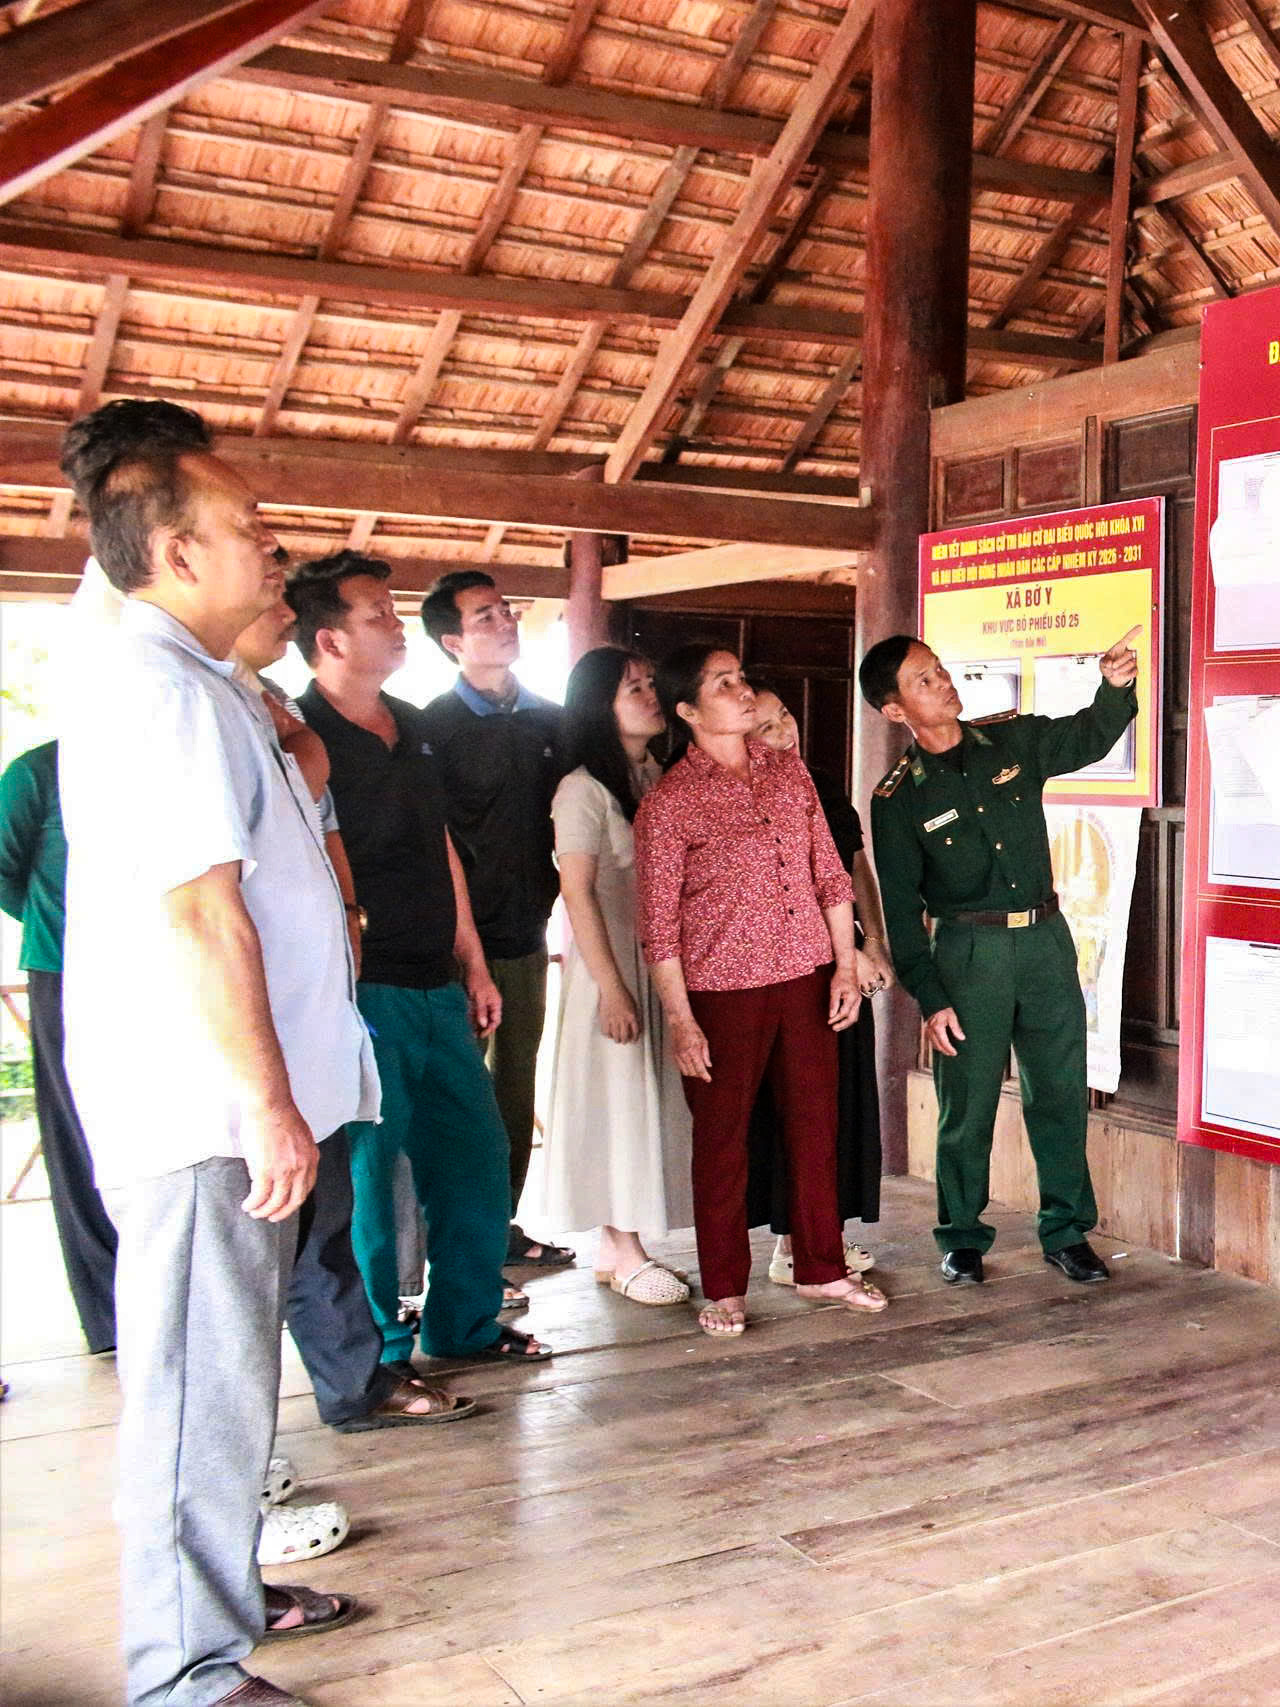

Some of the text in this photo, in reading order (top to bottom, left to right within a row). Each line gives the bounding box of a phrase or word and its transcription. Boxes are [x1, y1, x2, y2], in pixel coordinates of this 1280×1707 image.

[1110, 514, 1130, 536] KHÓA
[1132, 515, 1144, 532] XVI
[1087, 547, 1097, 567] KỲ
[1099, 548, 1116, 565] 2026
[1124, 545, 1141, 562] 2031
[1006, 587, 1021, 609] XÃ
[1045, 587, 1052, 605] Y
[1029, 612, 1053, 630] PHIẾU
[1055, 610, 1066, 628] SỐ
[1069, 613, 1079, 627] 25
